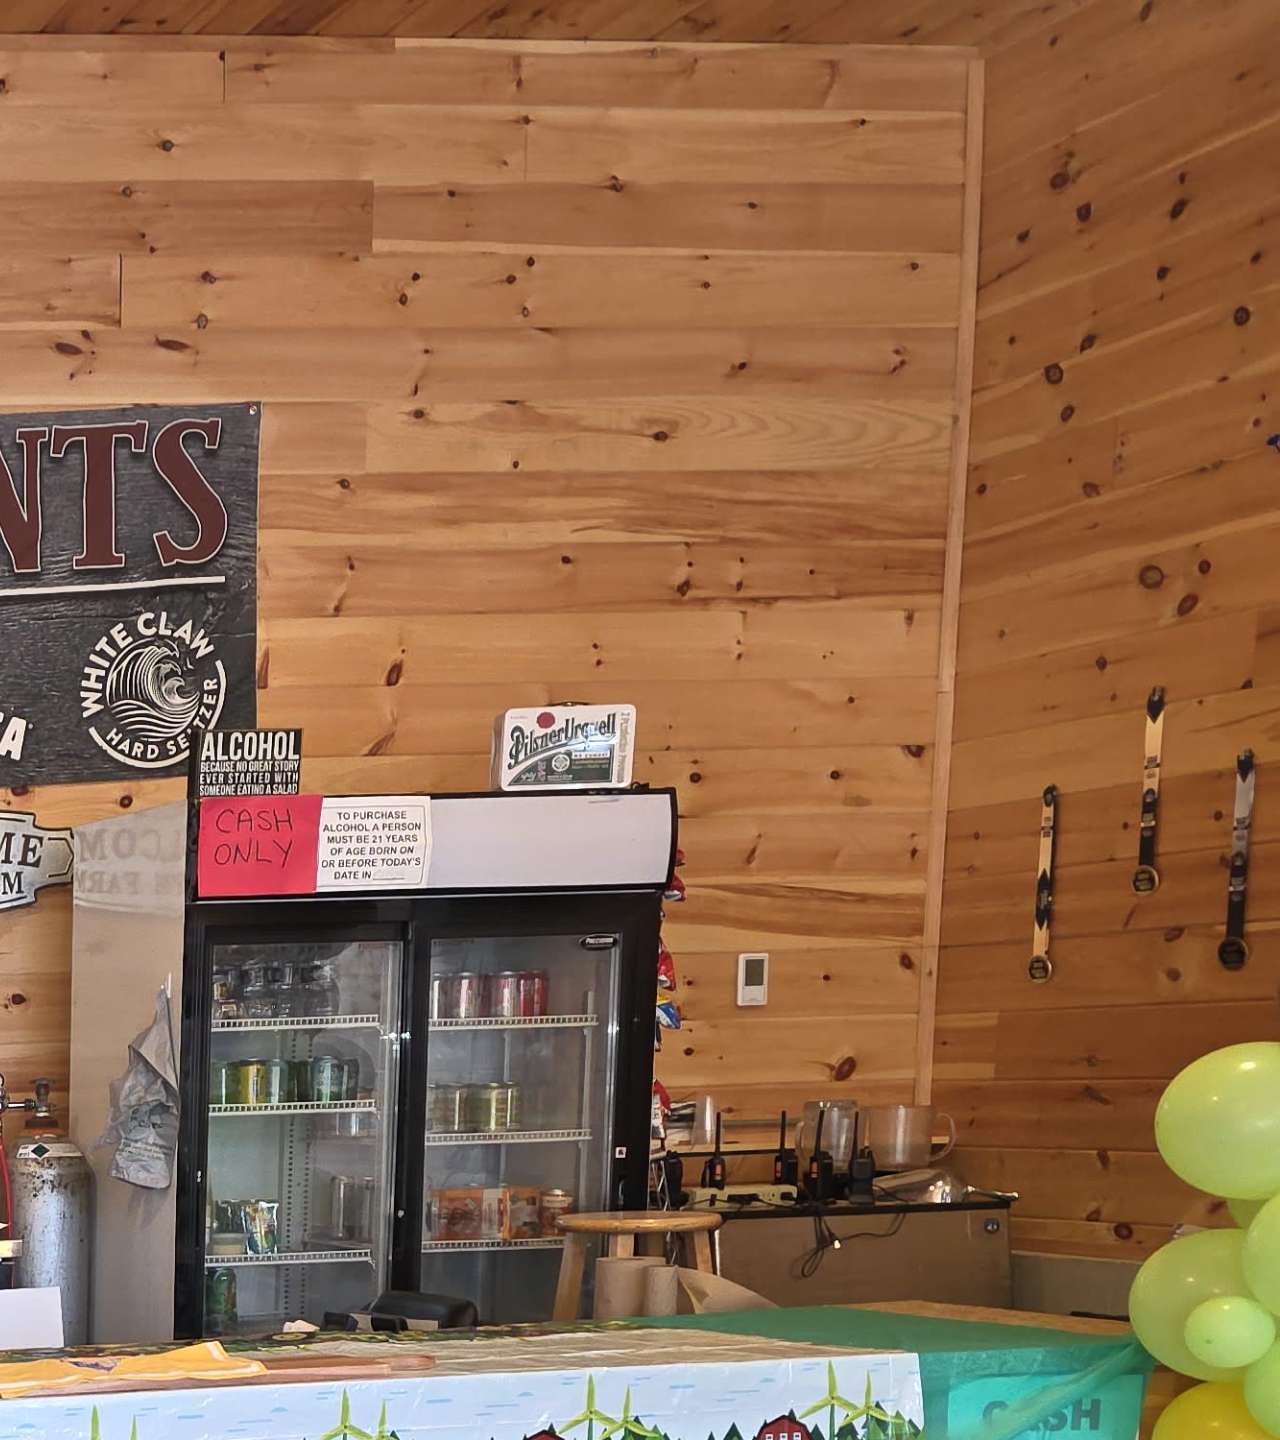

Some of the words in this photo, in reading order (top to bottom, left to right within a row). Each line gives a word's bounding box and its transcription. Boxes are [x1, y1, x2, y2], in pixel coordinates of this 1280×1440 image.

[80, 623, 133, 718] WHITE
[137, 611, 215, 659] CLAW
[106, 728, 159, 759] HARD
[167, 678, 218, 755] SETZER
[201, 731, 300, 760] ALCOHOL
[200, 761, 235, 772] BECAUSE
[236, 761, 248, 772] NO
[249, 760, 273, 772] GREAT
[274, 760, 299, 772] STORY
[200, 772, 224, 784] EVER
[228, 772, 271, 783] STARTED
[274, 772, 299, 783] WITH
[200, 784, 236, 796] SOMEONE
[237, 784, 265, 795] EATING
[265, 784, 271, 794] A
[273, 783, 298, 795] SALAD
[215, 808, 293, 834] CASH
[337, 811, 350, 820] TO
[353, 810, 407, 820] PURCHASE
[323, 823, 370, 832] ALCOHOL
[372, 823, 379, 831] A
[382, 822, 421, 831] PERSON
[327, 835, 353, 844] MUST
[356, 835, 369, 843] BE
[372, 835, 382, 843] 21
[385, 833, 418, 843] YEARS
[214, 840, 292, 869] ONLY
[330, 847, 343, 856] OF
[346, 847, 366, 856] AGE
[369, 846, 397, 855] BORN
[400, 846, 414, 854] ON
[321, 859, 335, 868] OR
[338, 859, 377, 868] BEFORE
[380, 857, 421, 867] TODAY'S
[334, 871, 359, 880] DATE
[362, 871, 372, 879] IN
